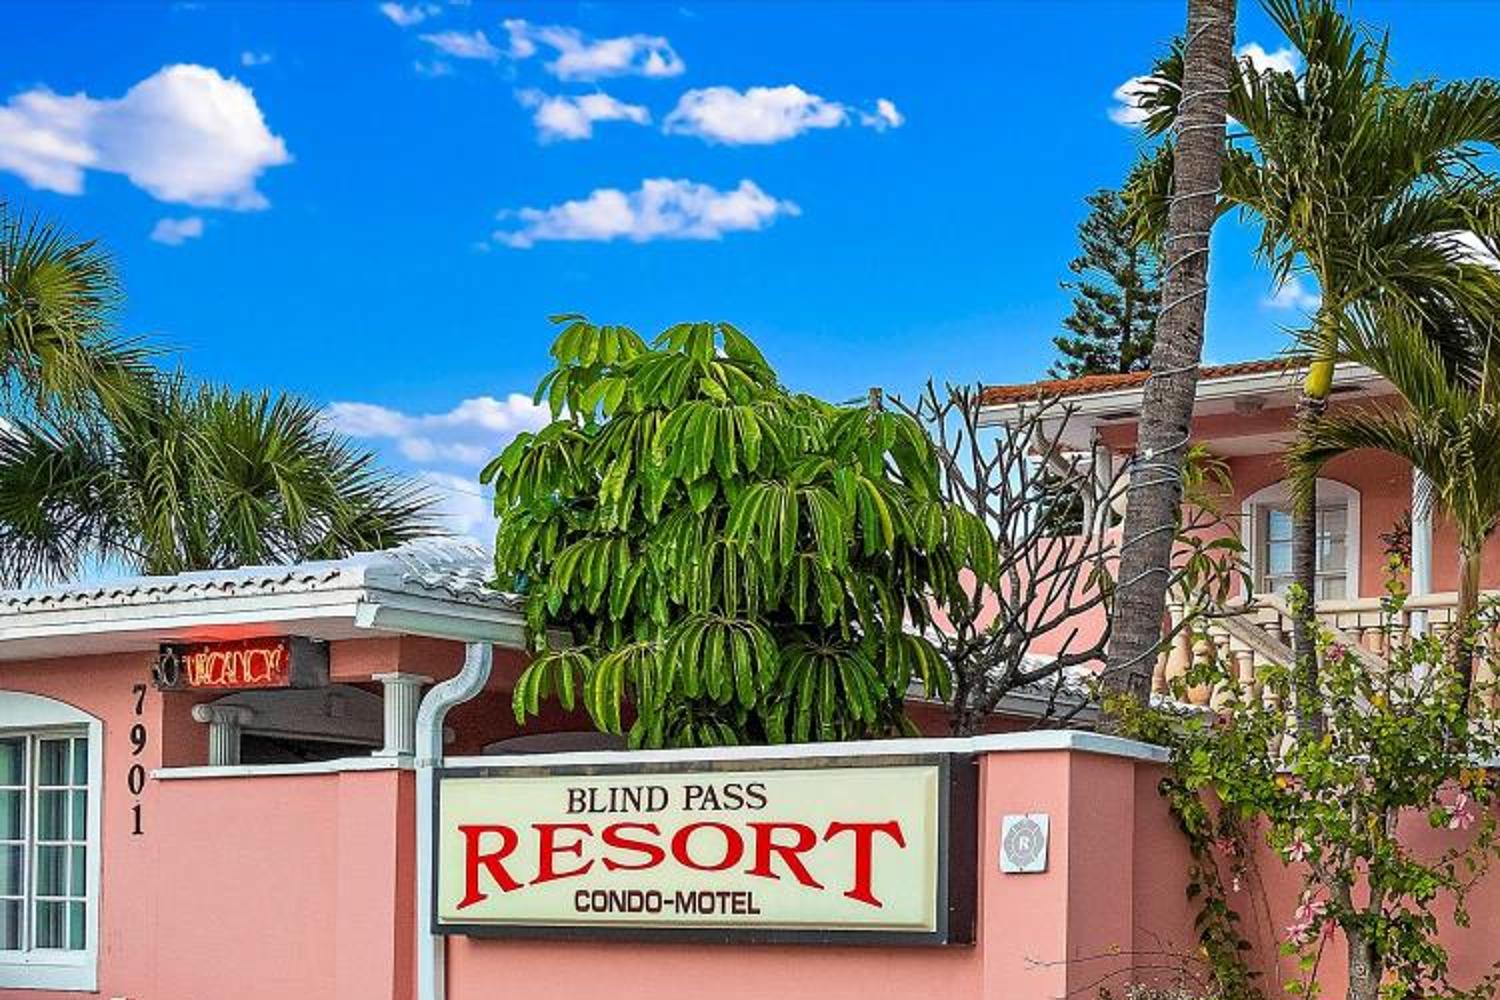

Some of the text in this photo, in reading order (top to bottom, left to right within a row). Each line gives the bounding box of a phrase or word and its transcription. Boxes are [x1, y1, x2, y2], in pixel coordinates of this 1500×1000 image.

[187, 648, 281, 687] VACANCY
[127, 683, 147, 835] 7901
[567, 782, 767, 813] BLIND PASS
[456, 820, 906, 911] RESORT
[574, 888, 761, 916] CONDO-MOTEL
